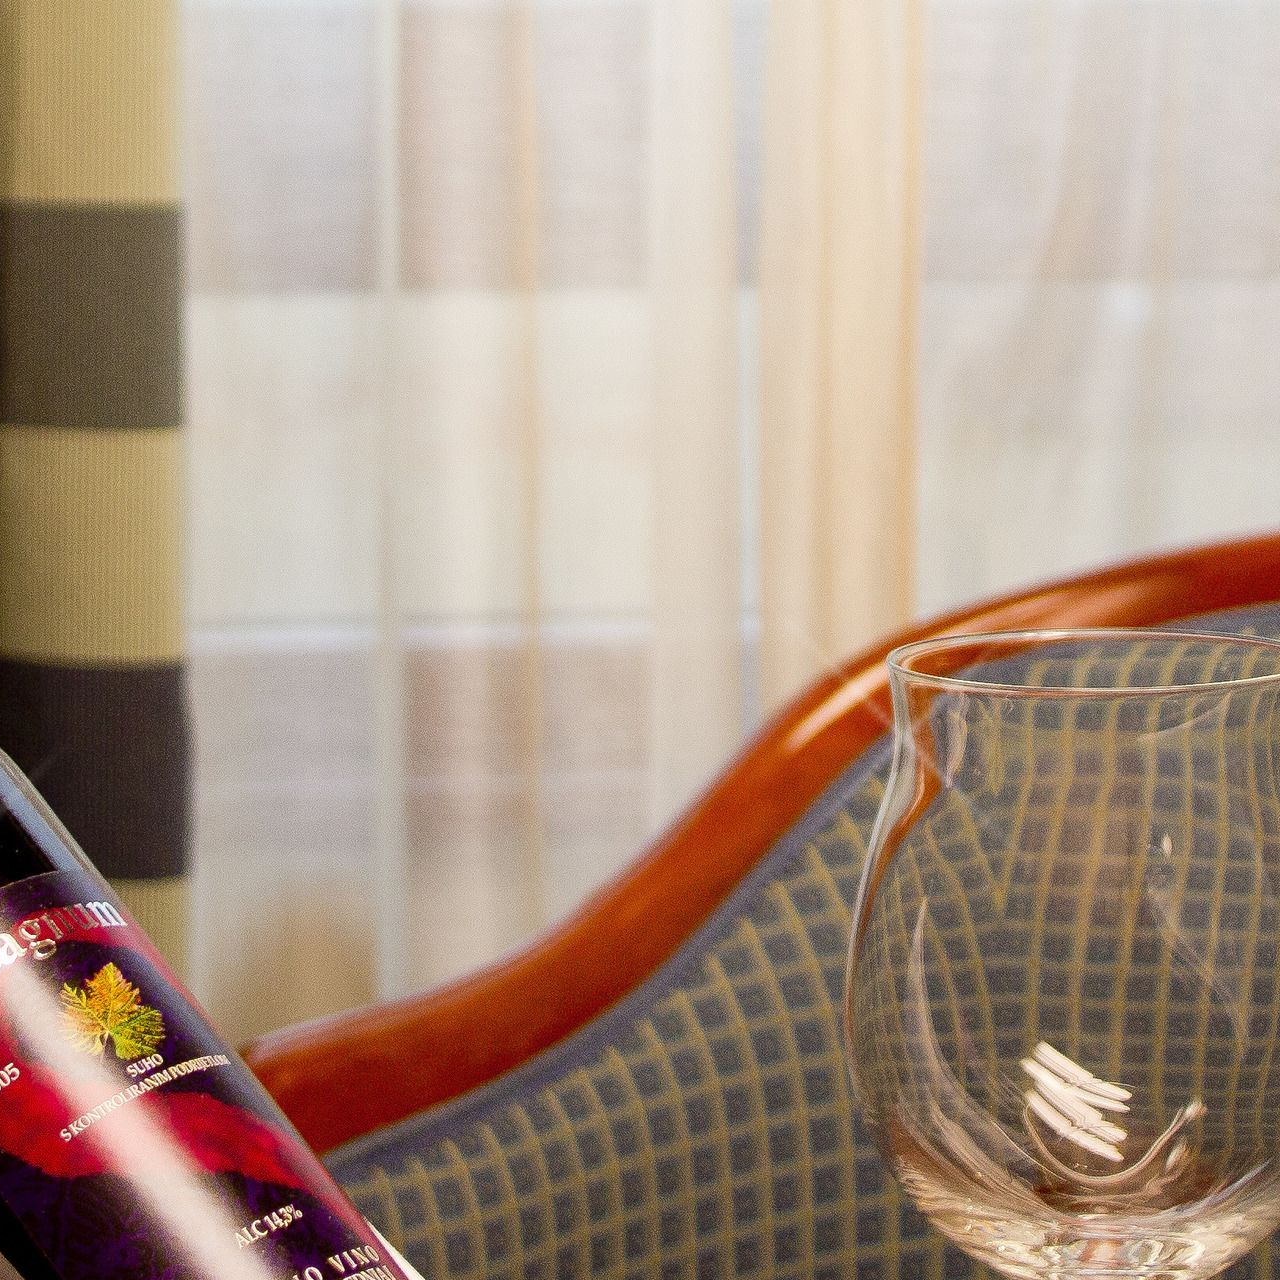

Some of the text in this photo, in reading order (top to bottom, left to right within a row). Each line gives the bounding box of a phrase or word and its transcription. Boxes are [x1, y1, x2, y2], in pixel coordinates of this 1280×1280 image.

[126, 1053, 164, 1078] SUHO
[59, 1127, 73, 1142] S
[69, 1067, 172, 1136] KONTROLIRANIM
[234, 1203, 303, 1250] ALC 14,3%
[328, 1245, 381, 1275] VINO
